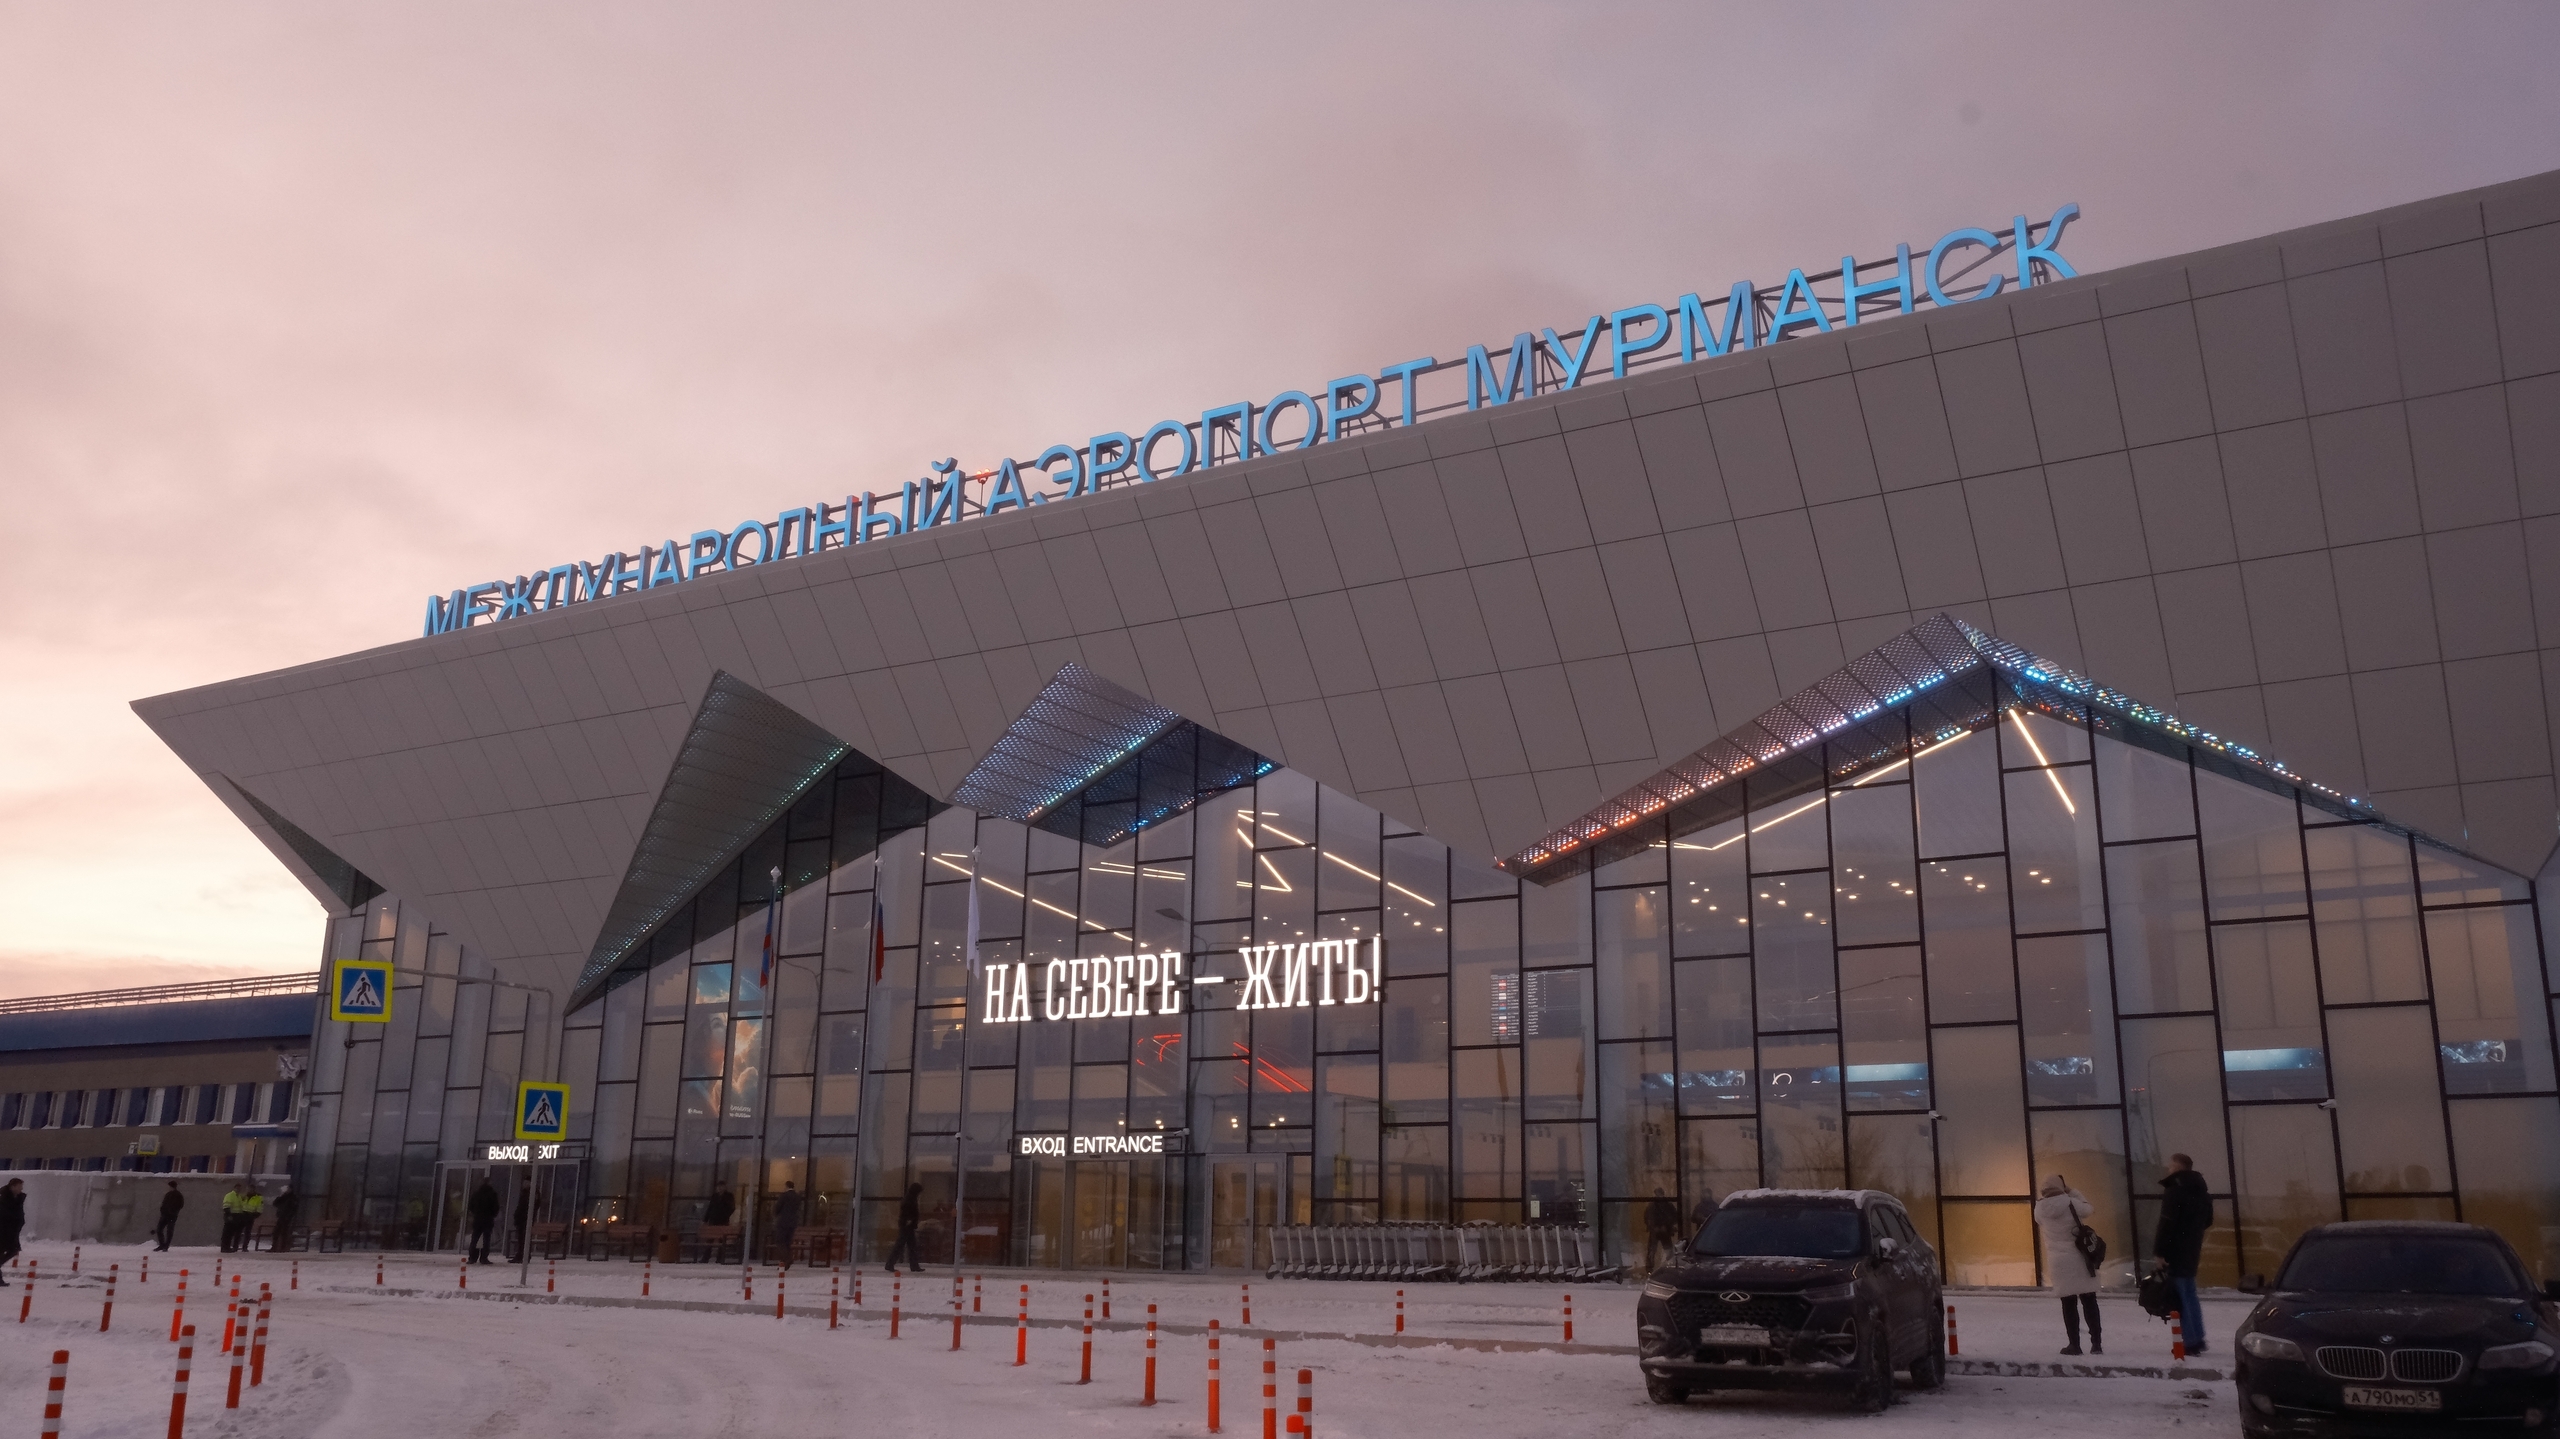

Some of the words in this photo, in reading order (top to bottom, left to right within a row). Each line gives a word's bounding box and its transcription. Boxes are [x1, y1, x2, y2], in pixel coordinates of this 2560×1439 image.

[423, 457, 966, 638] МЕЖДУНАРОДНЫЙ
[984, 356, 1438, 517] АЭРОПОРТ
[1467, 202, 2080, 411] МУРМАНСК
[983, 962, 1032, 1024] НА
[1045, 951, 1182, 1021] СЕВЕРЕ
[1236, 936, 1381, 1011] ЖИТЬ!
[488, 1145, 529, 1163] ВЫХОД
[1021, 1137, 1066, 1157] ВХОД
[1073, 1135, 1163, 1154] ENTRANCE
